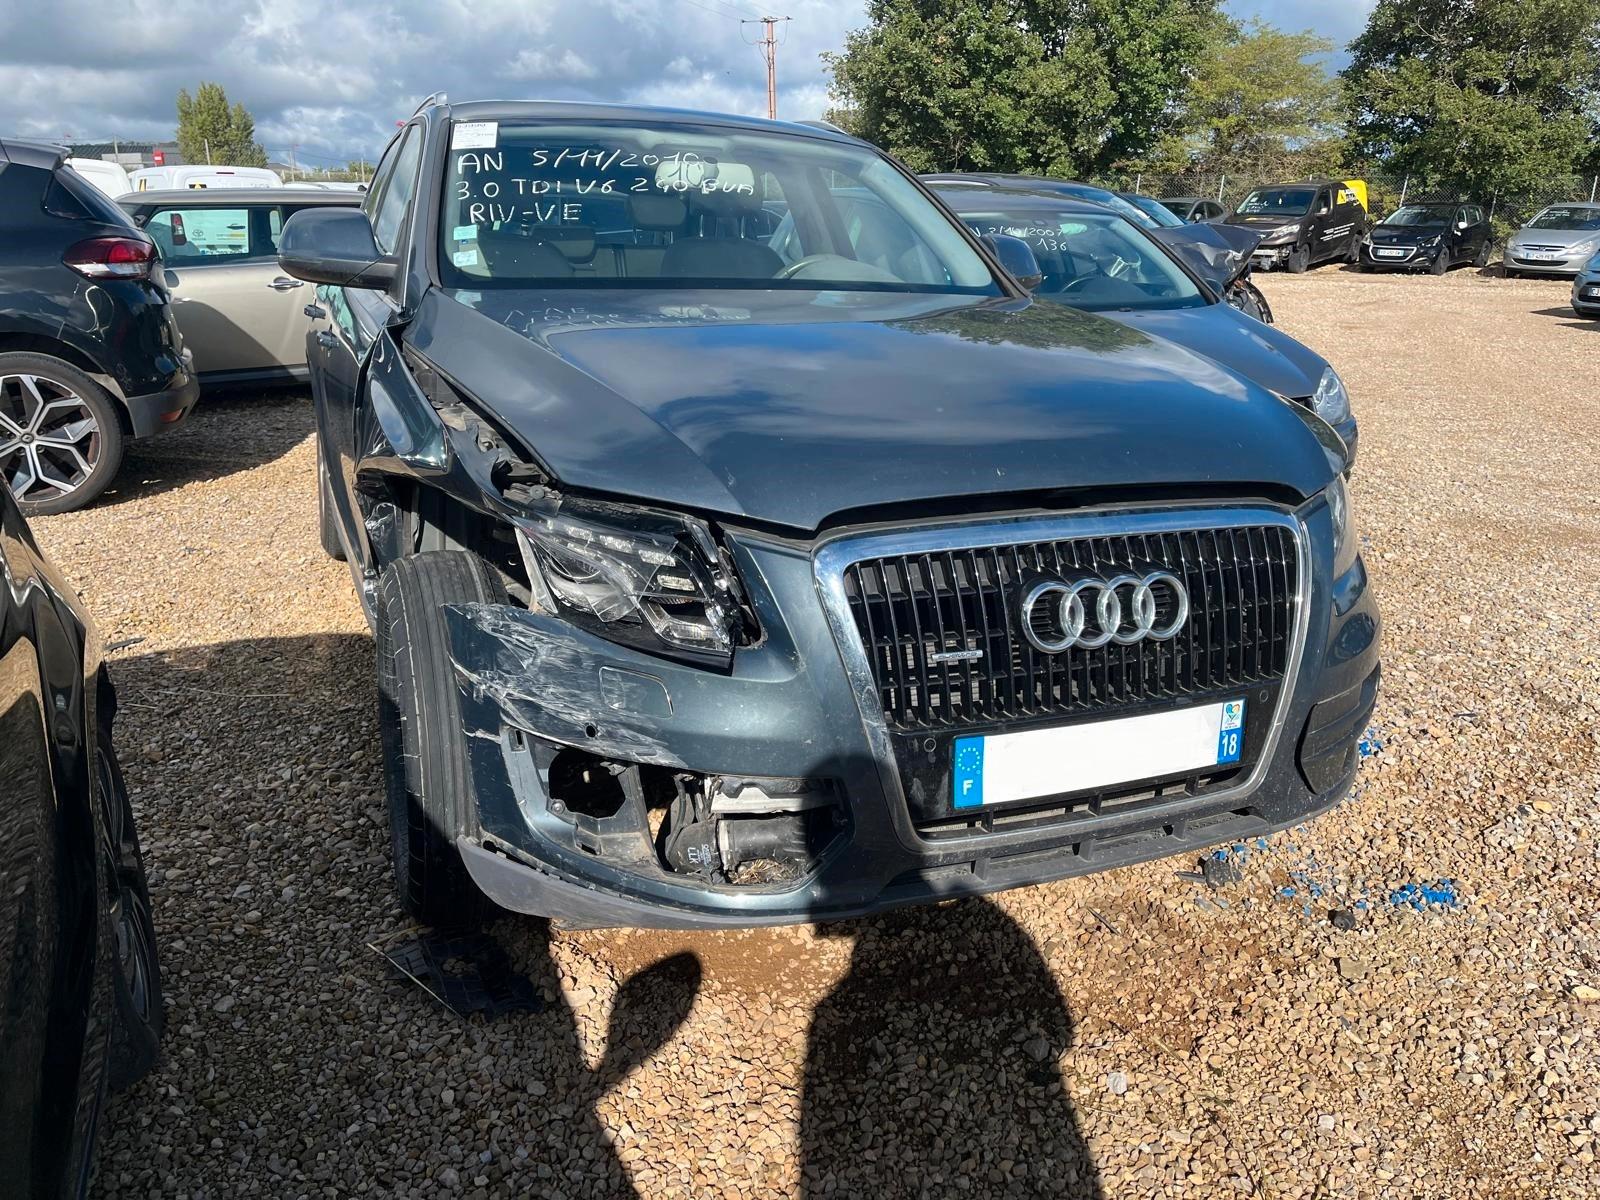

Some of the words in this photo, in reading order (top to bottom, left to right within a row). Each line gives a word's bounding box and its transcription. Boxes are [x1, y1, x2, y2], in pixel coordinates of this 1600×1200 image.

[457, 151, 503, 174] AN
[456, 180, 499, 200] 3.0
[511, 178, 561, 195] TDI
[1036, 237, 1067, 251] 136
[1222, 733, 1238, 757] 18
[963, 779, 974, 796] F
